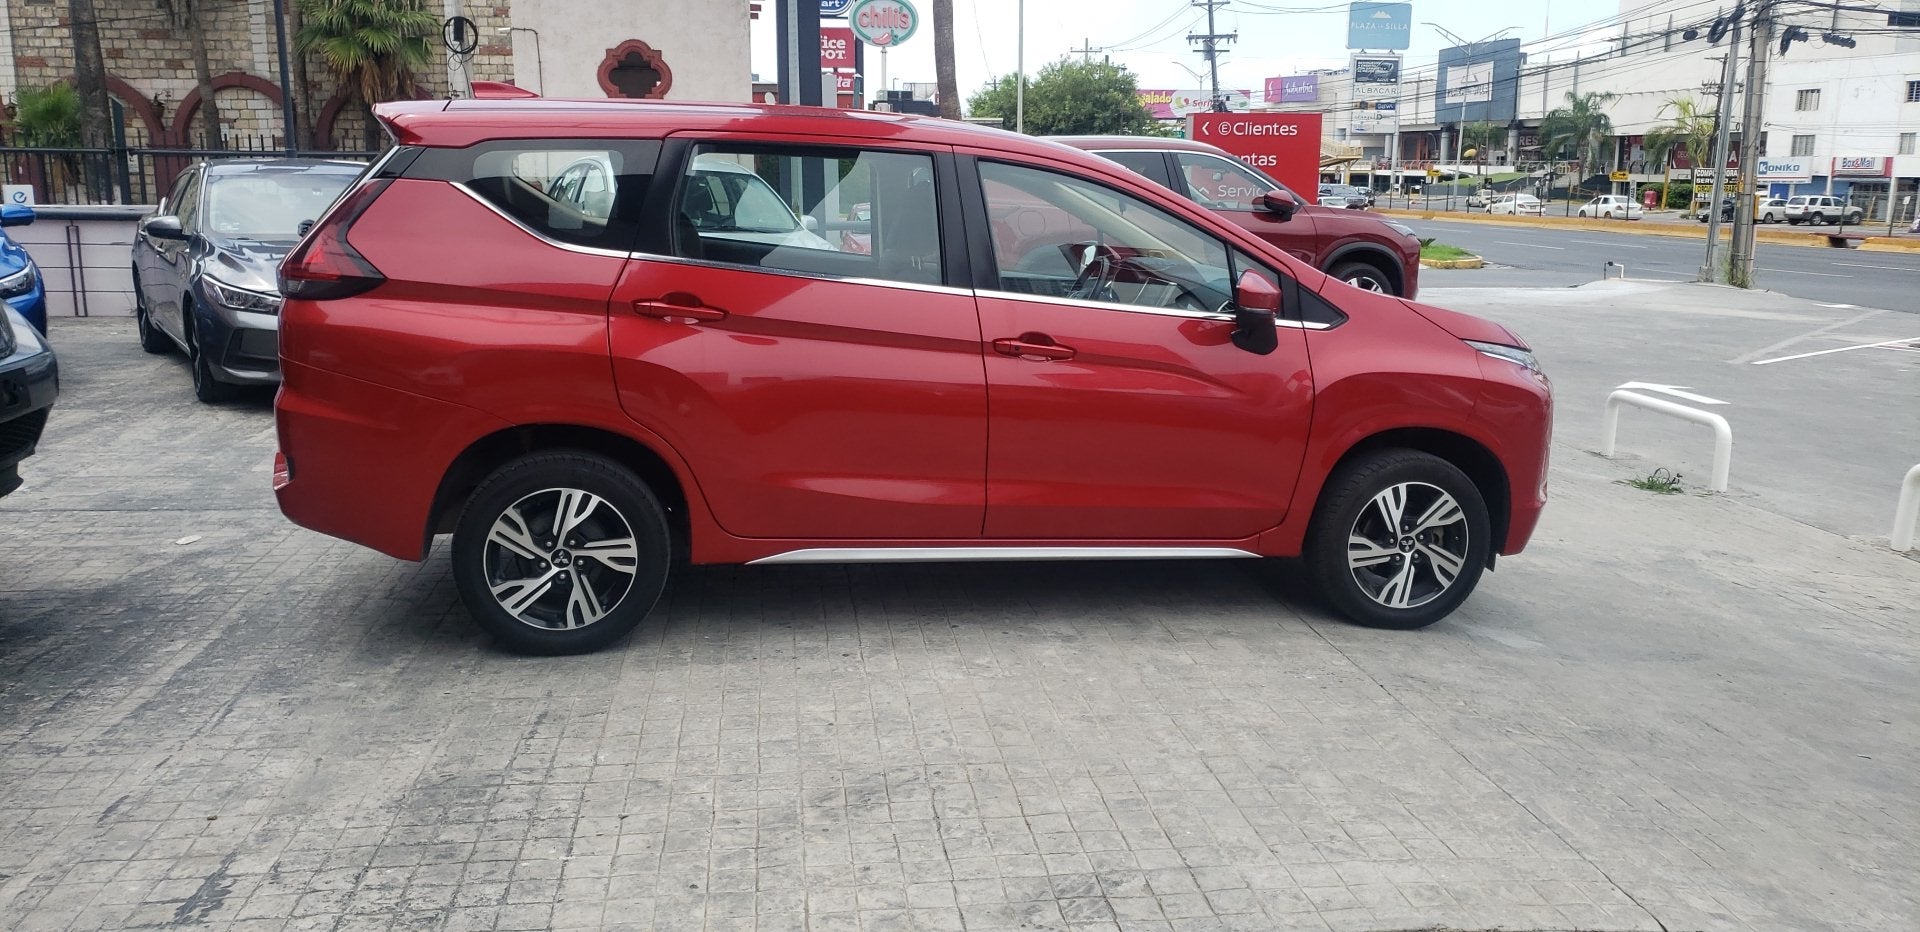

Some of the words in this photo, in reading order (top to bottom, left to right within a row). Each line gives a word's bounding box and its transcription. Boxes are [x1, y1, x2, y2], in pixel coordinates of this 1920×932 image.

[858, 6, 910, 29] chili's
[821, 35, 846, 49] ice
[837, 76, 852, 88] ta
[1284, 81, 1313, 97] Suburbia
[1233, 121, 1298, 136] Clientes
[1236, 153, 1277, 166] ntas
